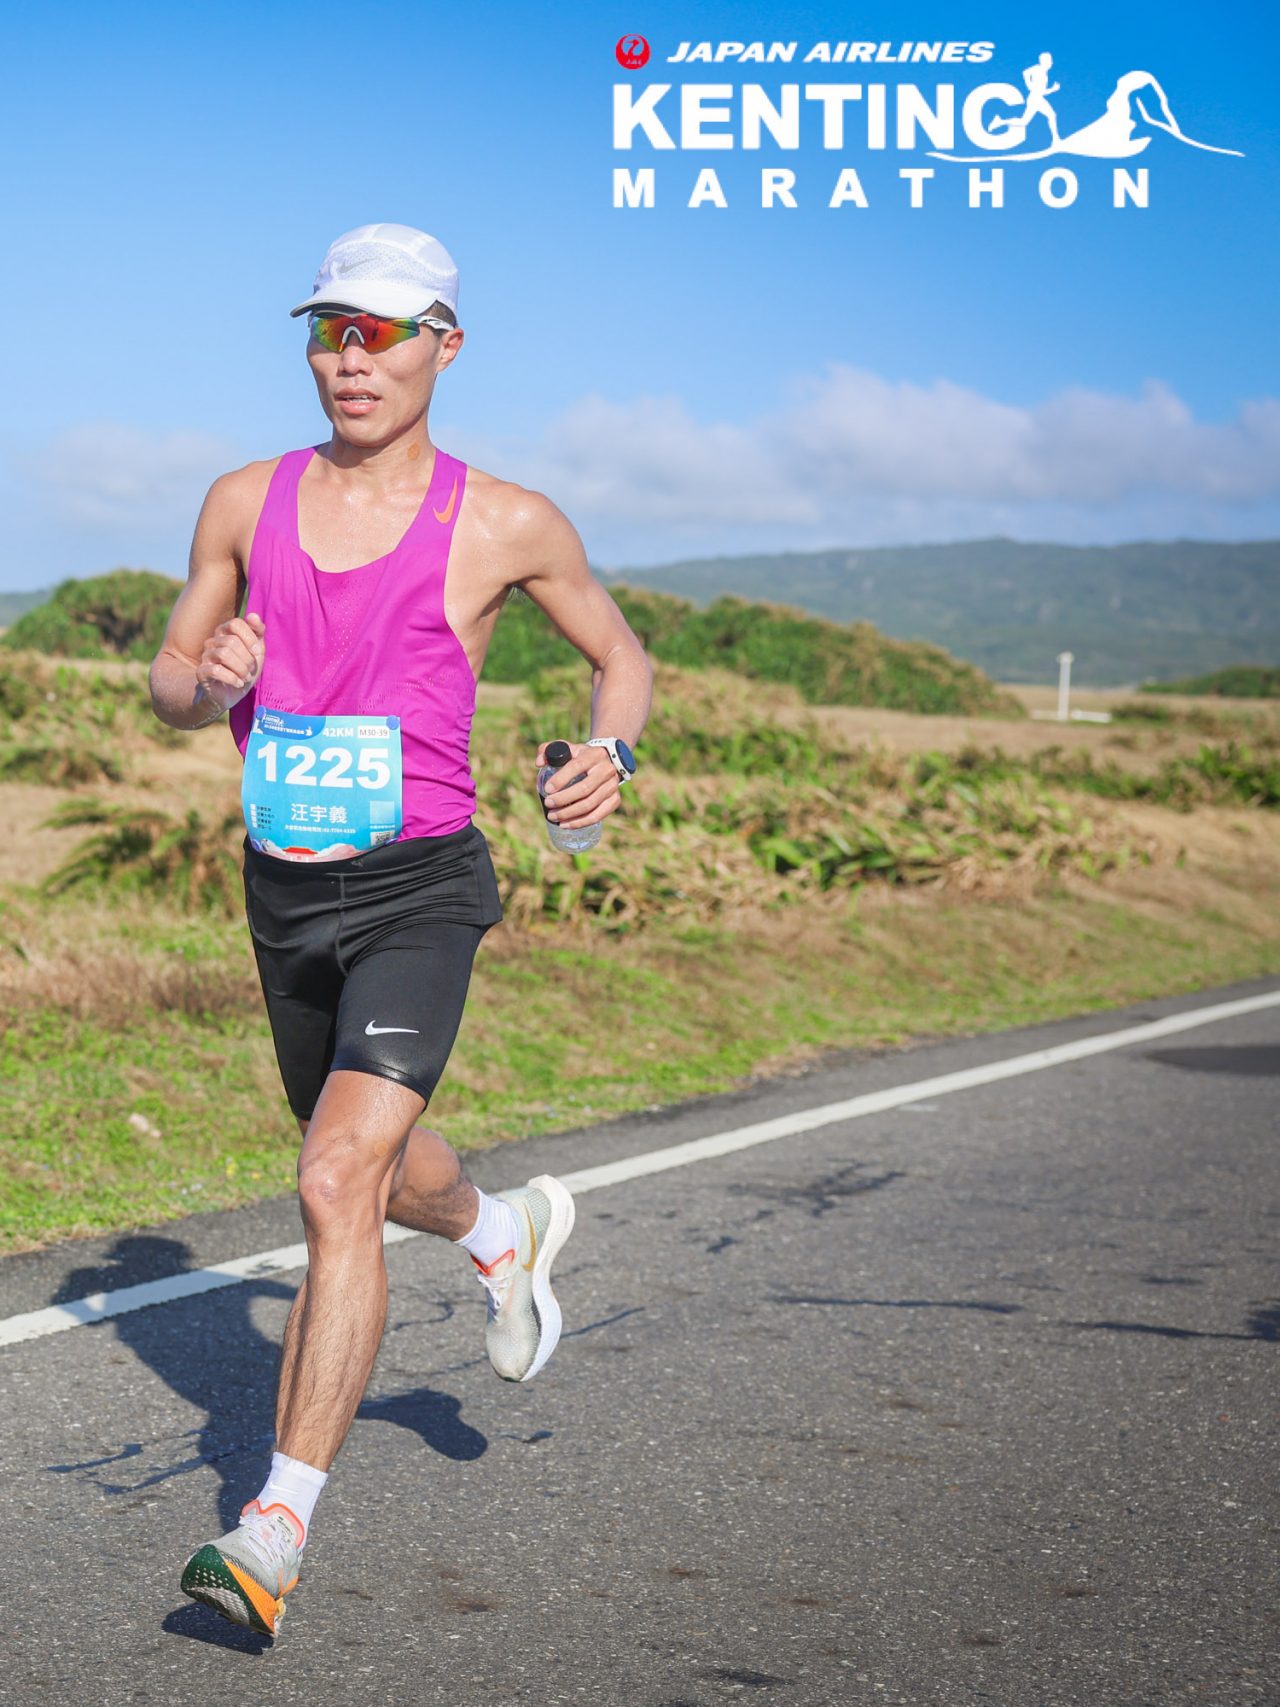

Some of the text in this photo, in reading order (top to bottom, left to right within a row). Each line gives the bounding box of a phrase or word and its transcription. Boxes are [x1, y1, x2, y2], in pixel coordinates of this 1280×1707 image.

[323, 726, 388, 737] 42KM M30-39
[257, 741, 391, 789] 1225
[290, 803, 348, 824] 汪宇義
